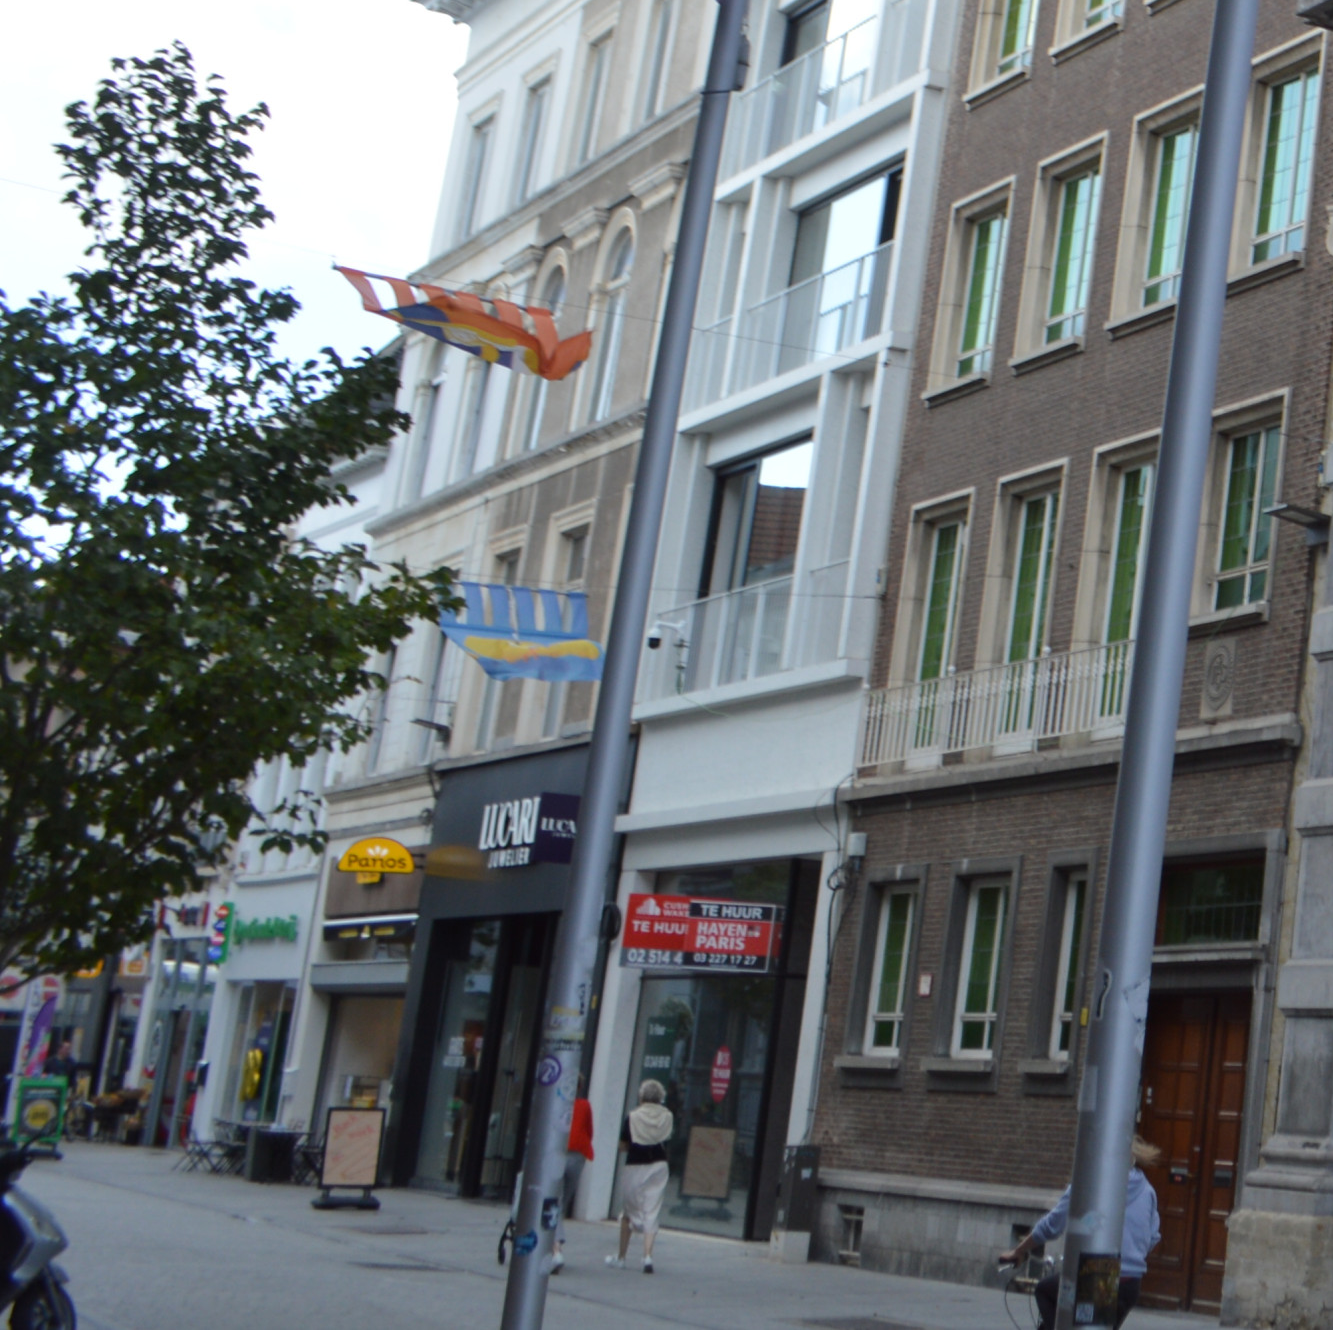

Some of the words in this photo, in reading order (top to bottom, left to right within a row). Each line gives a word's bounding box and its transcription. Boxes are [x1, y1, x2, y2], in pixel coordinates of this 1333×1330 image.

[479, 796, 541, 851] LUCARI
[347, 854, 407, 869] Panos
[488, 847, 530, 869] JUWELIER
[700, 905, 719, 917] TE
[722, 906, 763, 919] HUUR
[632, 921, 650, 933] TE
[654, 922, 688, 935] HUU
[697, 922, 747, 937] HAYEN
[695, 936, 746, 950] PARIS
[627, 949, 644, 963] 02
[648, 950, 670, 963] 514
[708, 954, 726, 964] 227
[730, 955, 741, 964] 17
[743, 955, 757, 965] 27
